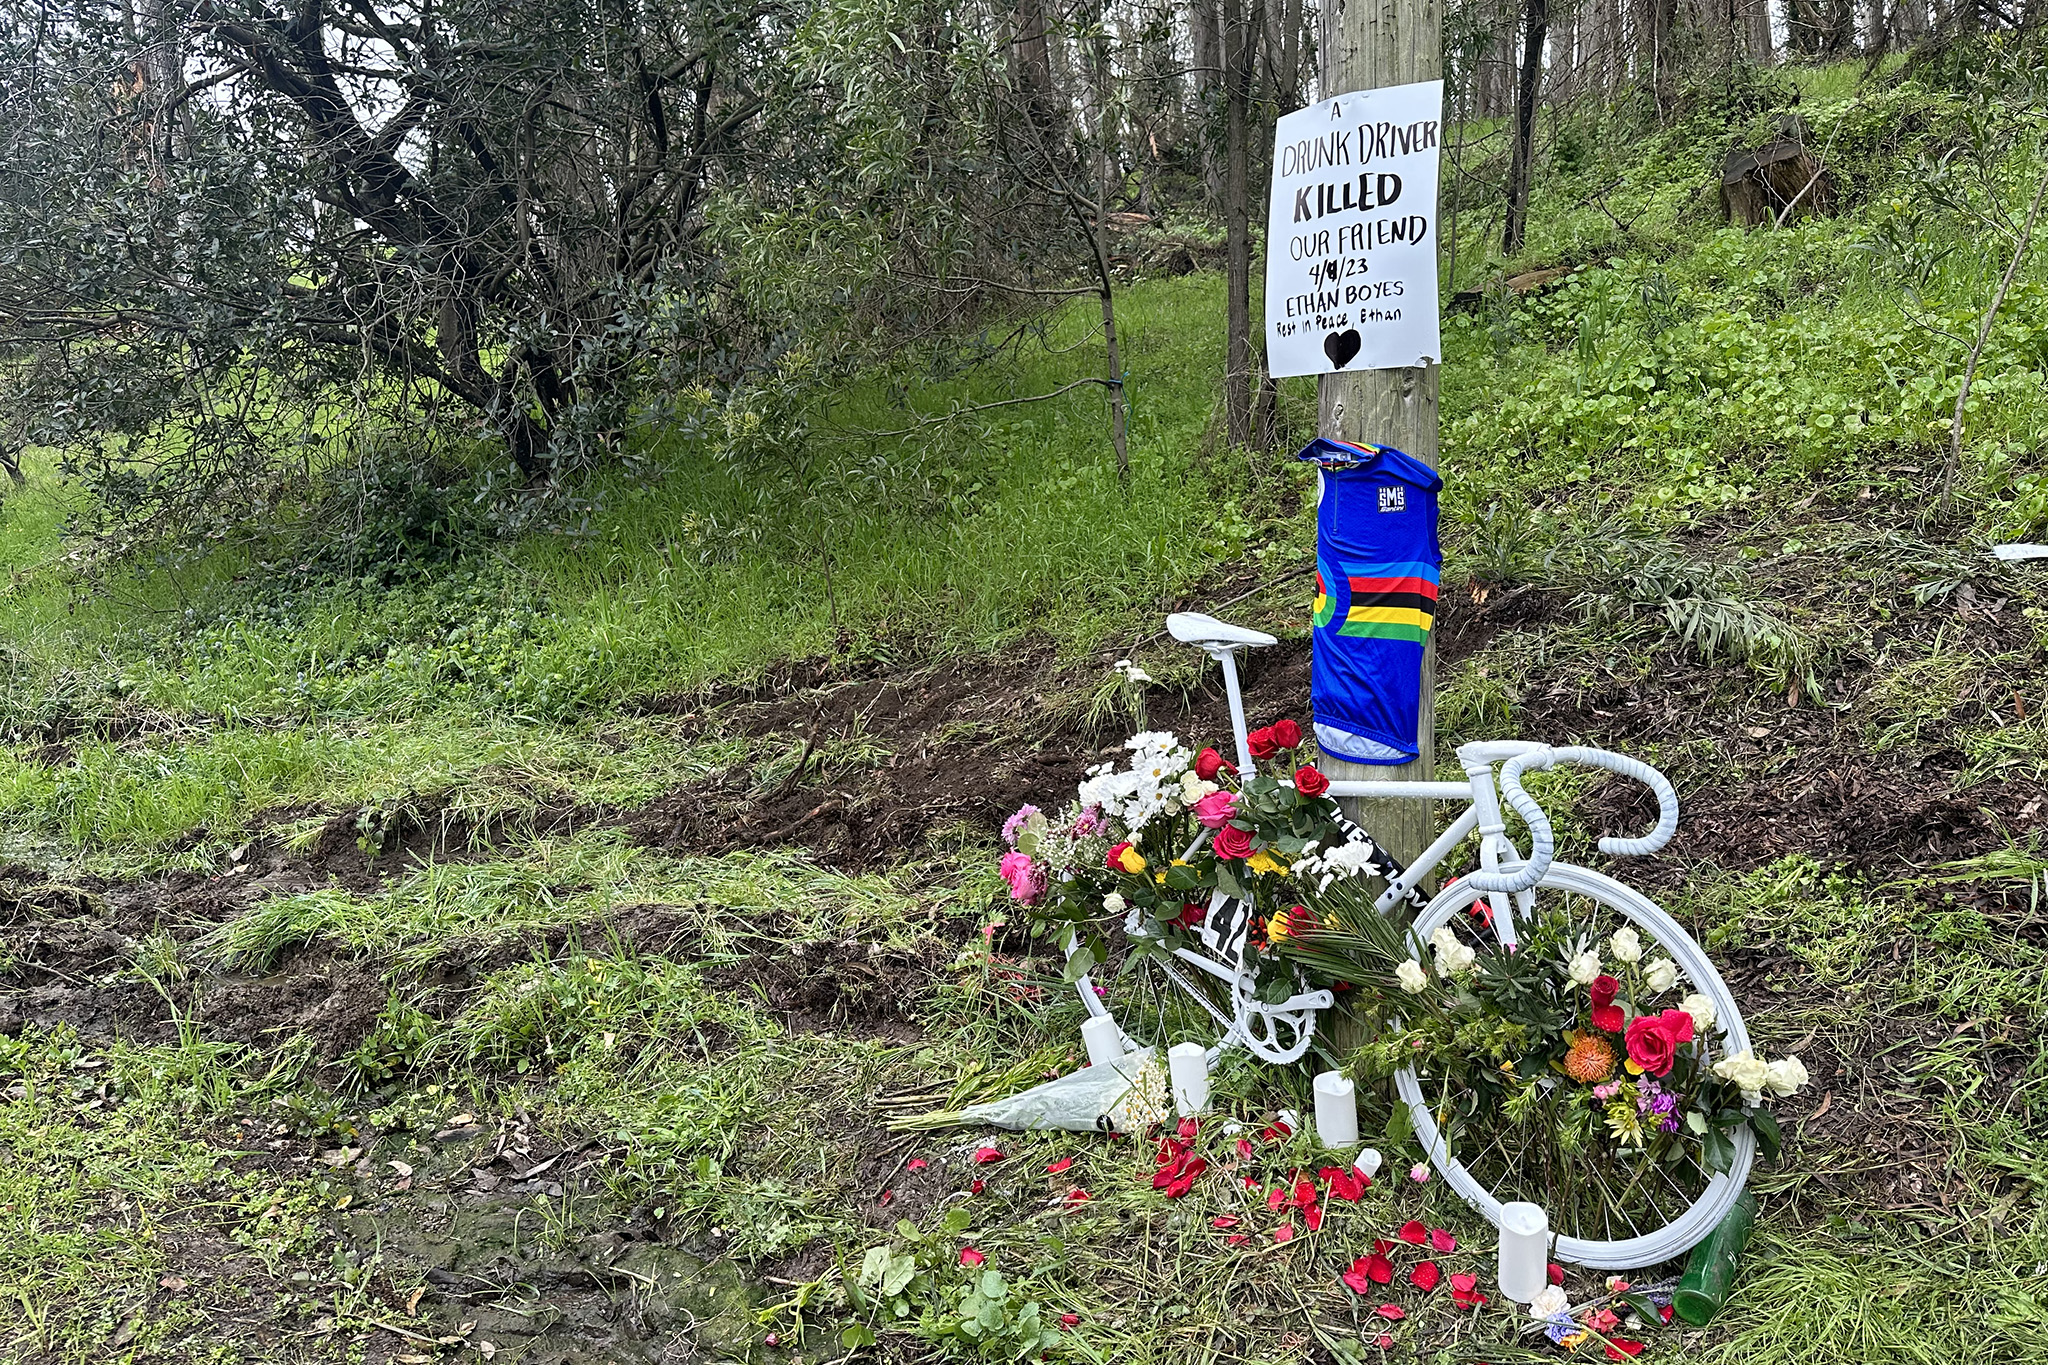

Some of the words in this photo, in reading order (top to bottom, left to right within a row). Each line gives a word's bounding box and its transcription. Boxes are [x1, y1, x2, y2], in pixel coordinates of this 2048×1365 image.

[1331, 102, 1342, 121] A
[1282, 130, 1351, 178] DRUNK
[1358, 120, 1439, 165] DRIVER
[1293, 173, 1402, 223] KILLED
[1290, 229, 1330, 261] OUR
[1338, 215, 1428, 254] FRIEND
[1286, 288, 1340, 318] ETHAN
[1345, 280, 1404, 305] BOYES
[1276, 321, 1297, 338] Rest
[1360, 308, 1402, 324] Ethan
[1379, 486, 1405, 507] SMS
